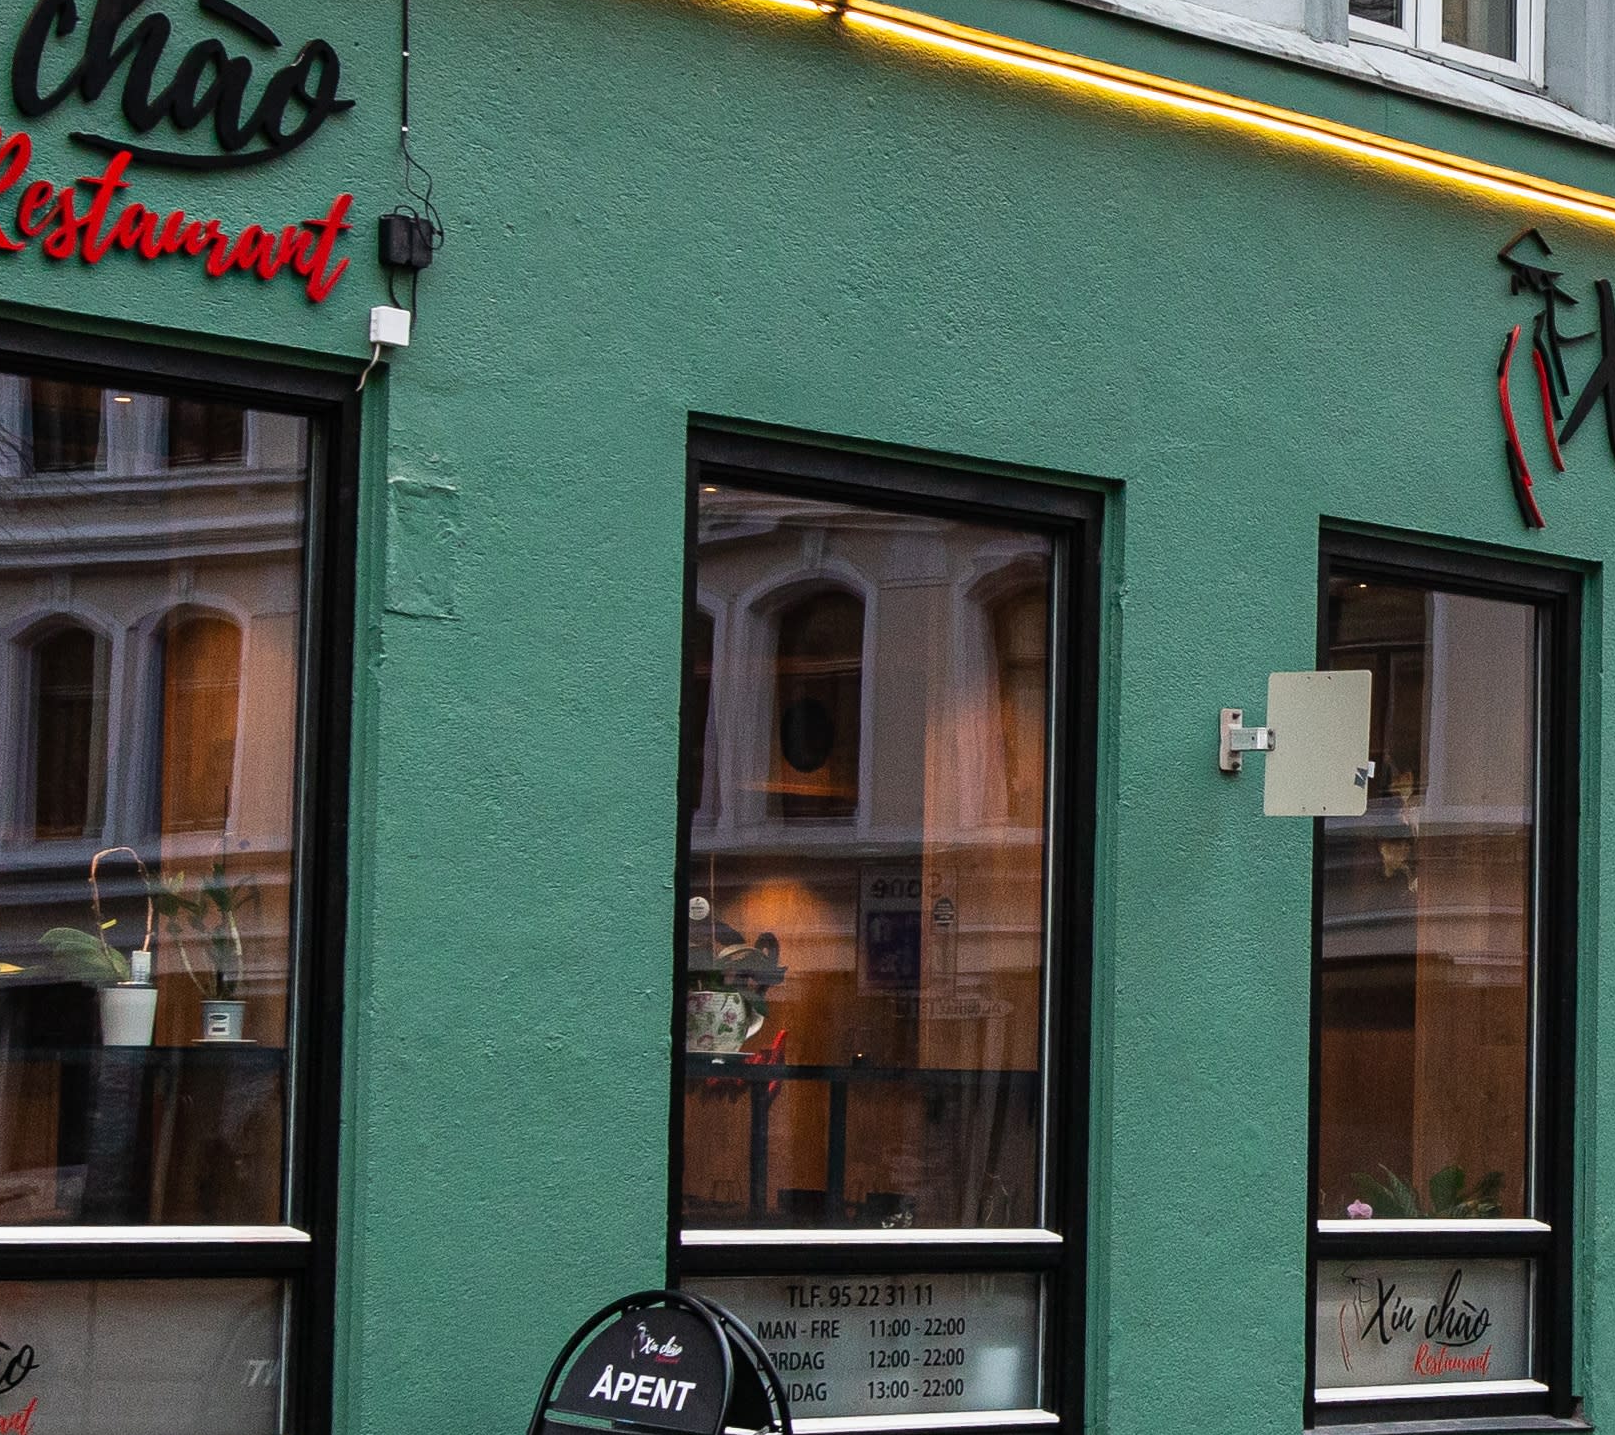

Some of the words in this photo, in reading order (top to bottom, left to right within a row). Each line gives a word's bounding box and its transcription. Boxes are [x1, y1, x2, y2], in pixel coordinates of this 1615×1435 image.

[788, 1285, 823, 1309] TLF.
[829, 1284, 851, 1308] 95
[858, 1284, 880, 1307] 22
[884, 1284, 906, 1307] 31
[914, 1284, 934, 1306] 11
[1361, 1277, 1417, 1344] Xin
[1424, 1269, 1492, 1347] chào
[757, 1321, 797, 1340] MAN
[811, 1320, 840, 1339] FRE
[869, 1319, 911, 1338] 11:00
[924, 1318, 966, 1336] 22:00
[639, 1336, 659, 1354] Xin
[868, 1350, 910, 1369] 12:00
[924, 1348, 965, 1367] 22:00
[1414, 1344, 1493, 1375] Restaurant
[589, 1363, 696, 1413] ÅPENT
[867, 1380, 909, 1400] 13:00
[923, 1378, 964, 1397] 22:00
